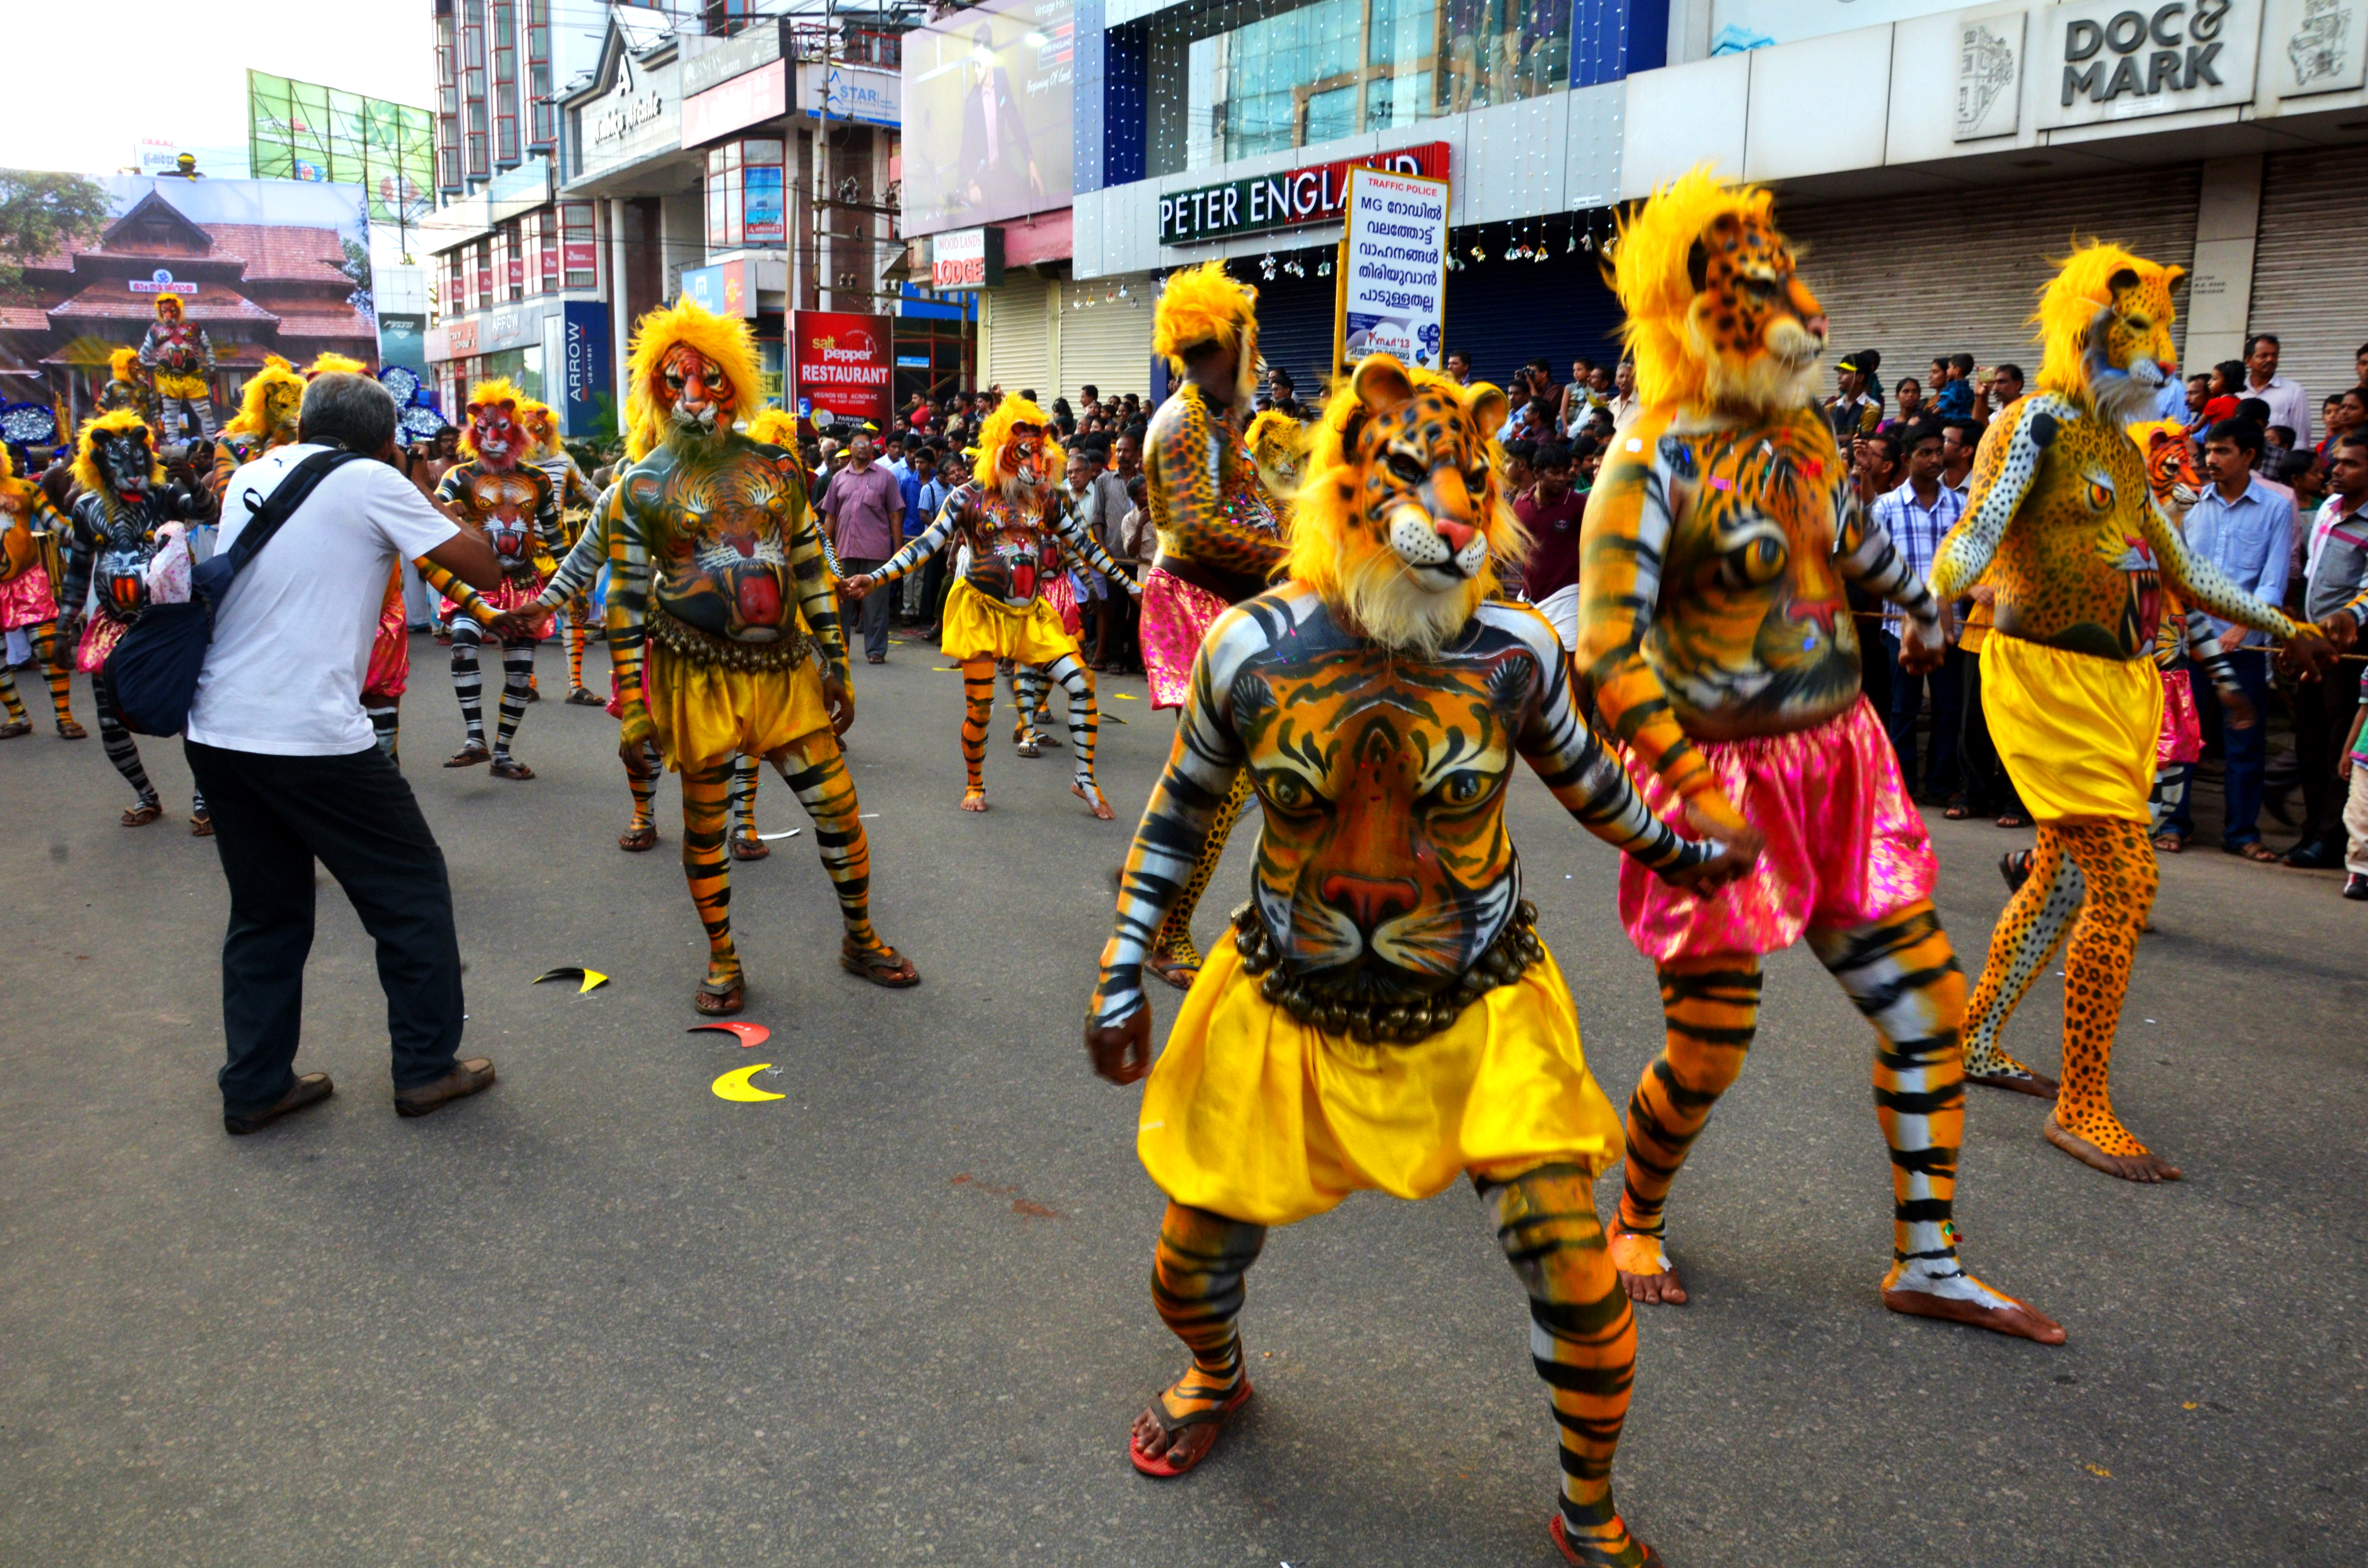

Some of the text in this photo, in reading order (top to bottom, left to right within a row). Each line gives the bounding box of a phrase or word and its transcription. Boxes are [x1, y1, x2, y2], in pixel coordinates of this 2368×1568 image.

[1035, 4, 1055, 16] Vintage
[1052, 38, 1072, 50] ENGLAND
[2061, 42, 2223, 106] MARK
[840, 85, 877, 102] STAR
[1027, 78, 1049, 98] Beginning
[1369, 178, 1437, 197] TRAFFIC POLICE
[1161, 187, 1238, 237] PETER
[1361, 196, 1442, 221] MG റോഡിൽ
[939, 234, 981, 251] WOOD LANDS
[1367, 221, 1435, 245] വലത്തോട്ട്
[1359, 243, 1438, 265] വാഹനങ്ങൾ
[932, 257, 985, 286] LODGE
[1359, 262, 1437, 286] തിരിയുവാൻ
[1360, 289, 1434, 313] പാടുള്ളതല്ല
[812, 335, 835, 350] salt
[568, 321, 581, 402] ARROW
[824, 348, 873, 363] pepper
[802, 364, 888, 384] RESTAURANT
